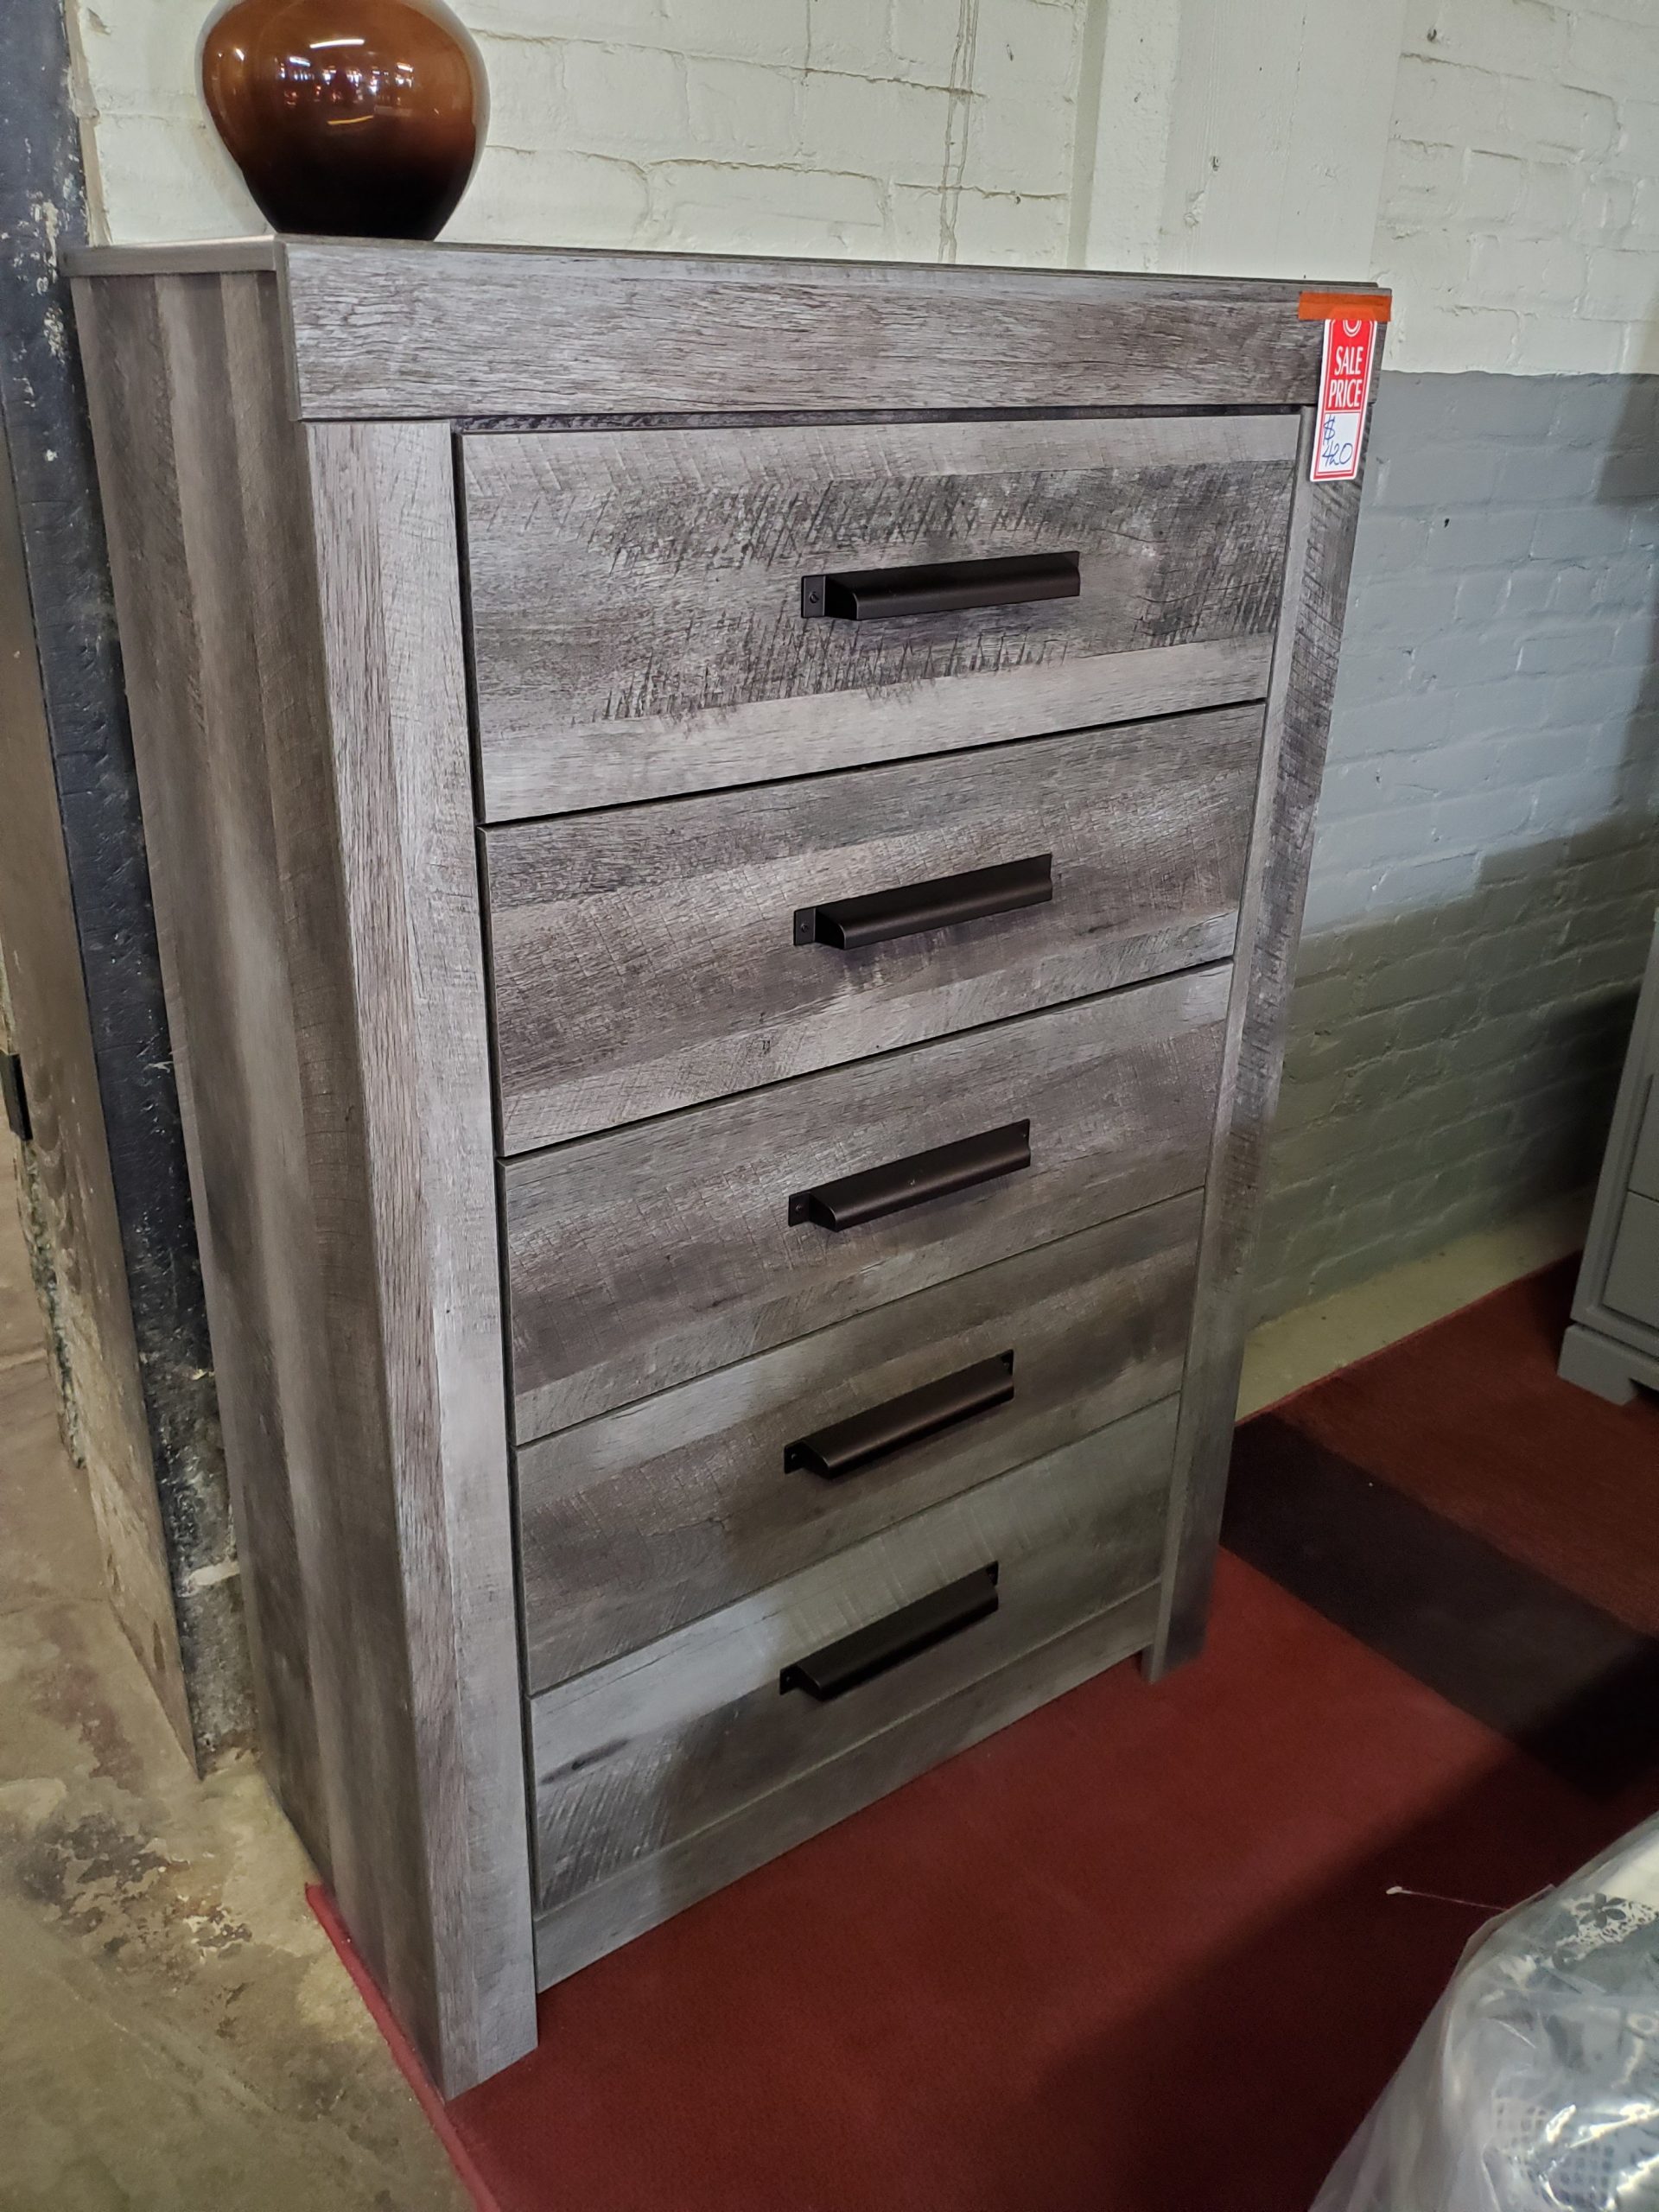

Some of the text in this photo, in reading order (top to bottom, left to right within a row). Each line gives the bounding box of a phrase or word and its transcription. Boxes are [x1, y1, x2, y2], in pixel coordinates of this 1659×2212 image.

[1334, 346, 1363, 375] SALE
[1328, 378, 1363, 408] PRICE
[1322, 414, 1335, 445] $
[1322, 442, 1353, 467] 420
